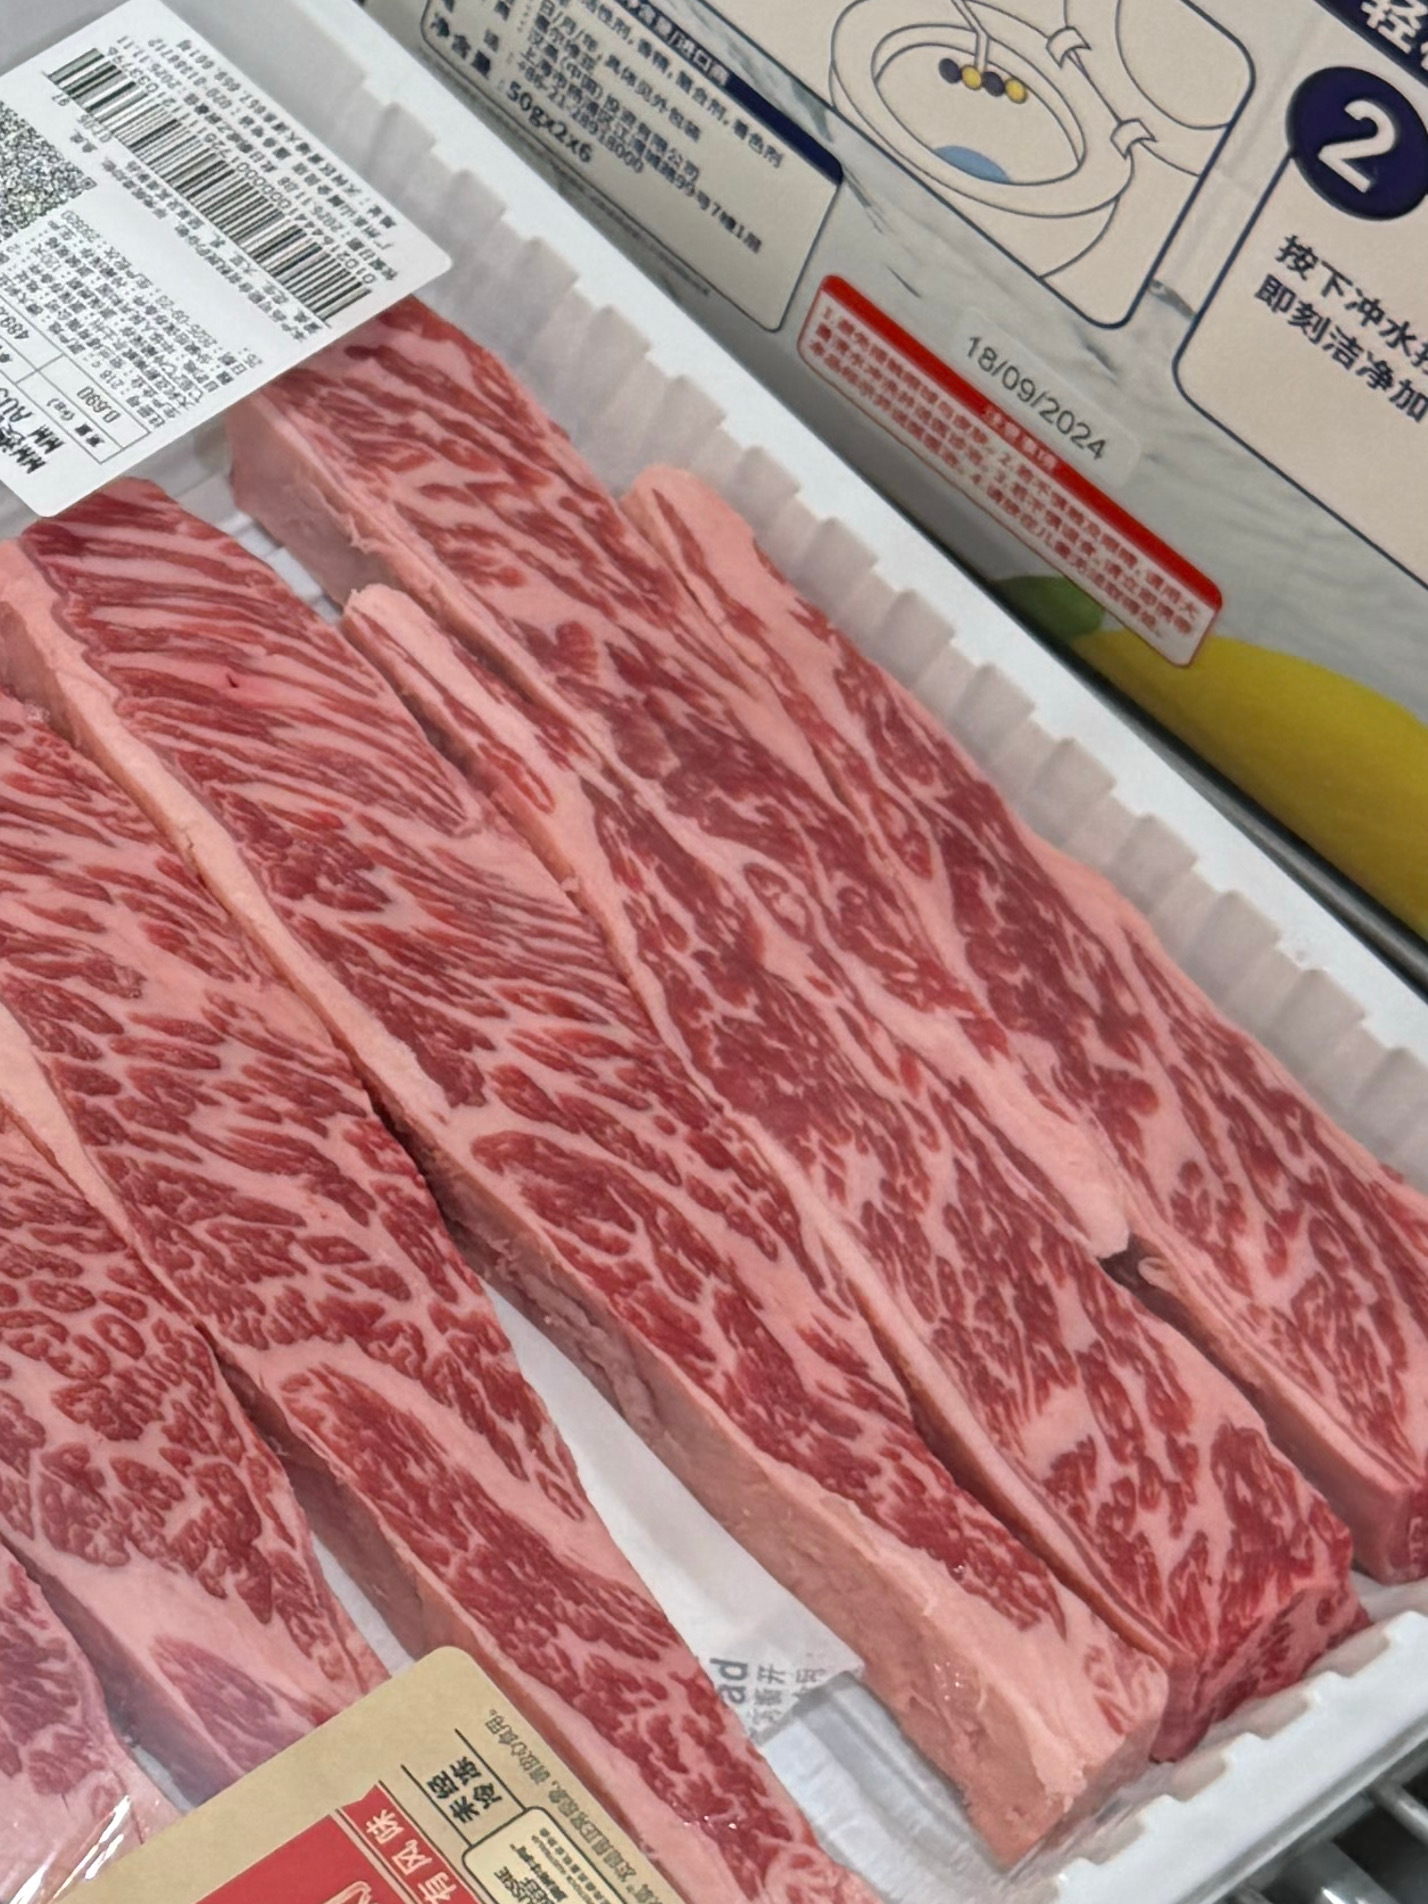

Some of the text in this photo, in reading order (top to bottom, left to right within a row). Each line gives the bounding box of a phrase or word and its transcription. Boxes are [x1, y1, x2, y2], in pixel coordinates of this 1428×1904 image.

[1318, 100, 1401, 192] 2
[75, 384, 122, 424] 0.690
[966, 336, 1106, 460] 18/09/2024
[425, 1769, 480, 1824] 未经
[448, 1755, 503, 1810] 冷冻
